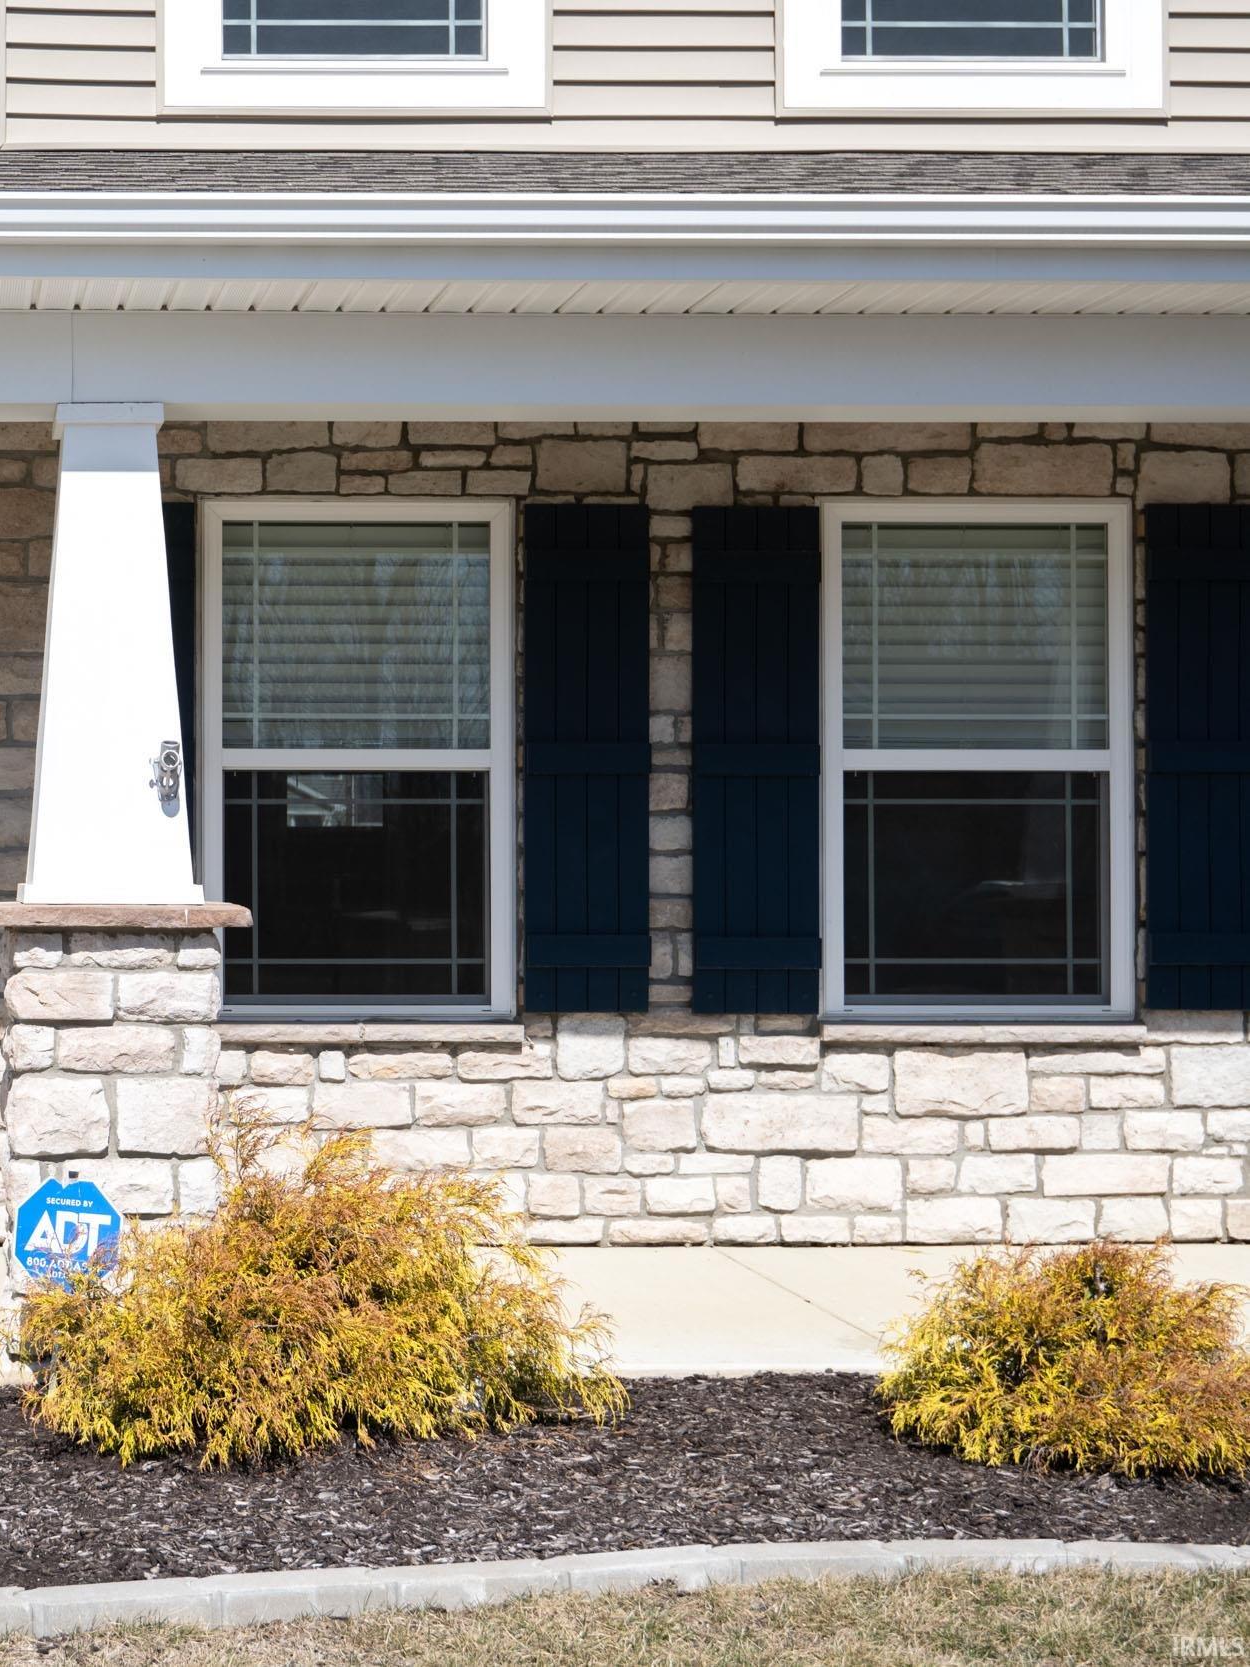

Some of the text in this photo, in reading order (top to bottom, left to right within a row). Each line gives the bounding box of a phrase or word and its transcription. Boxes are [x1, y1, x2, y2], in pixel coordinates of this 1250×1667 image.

[46, 1197, 94, 1207] SECURED BY
[24, 1209, 112, 1257] ADT
